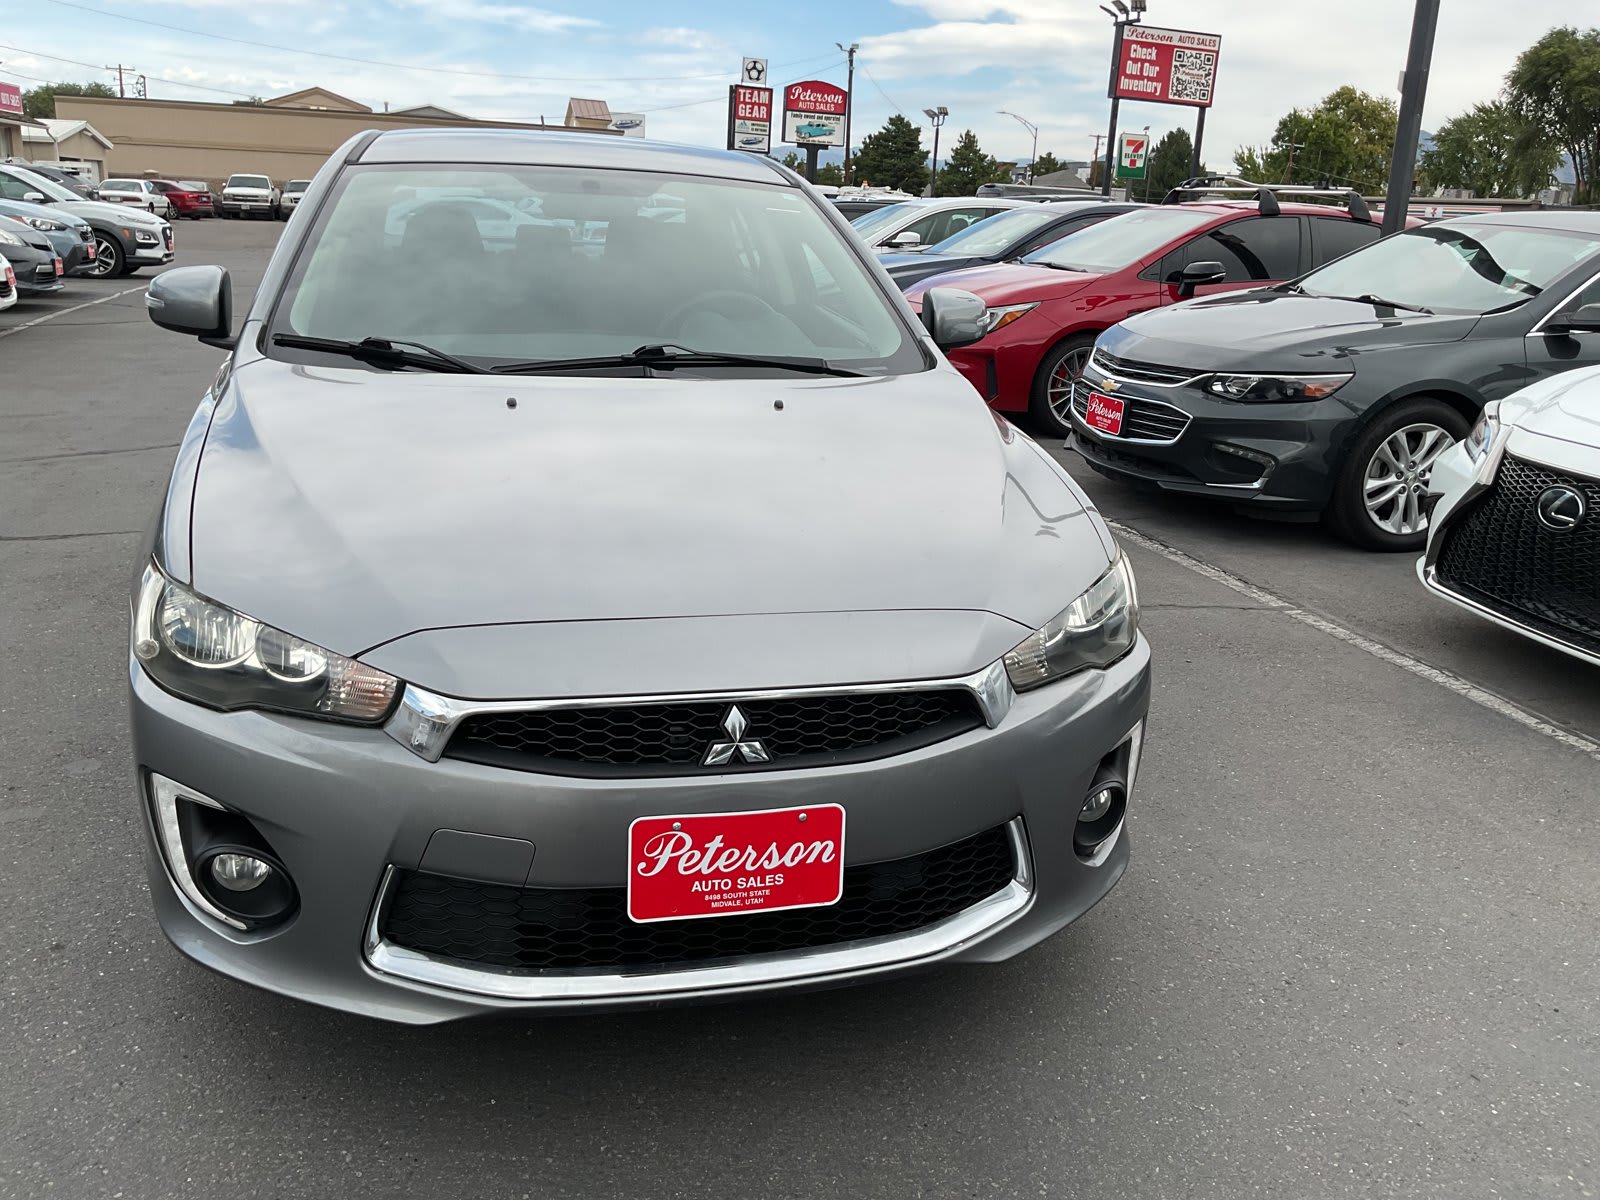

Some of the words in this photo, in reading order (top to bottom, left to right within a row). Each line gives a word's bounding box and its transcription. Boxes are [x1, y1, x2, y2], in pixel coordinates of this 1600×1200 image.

[1127, 27, 1173, 43] Peterson
[1178, 35, 1195, 45] AUTO
[1196, 37, 1217, 48] SALES
[1130, 44, 1157, 60] Check
[1126, 60, 1141, 75] Out
[1143, 63, 1160, 77] Our
[1120, 76, 1162, 96] Inventory
[738, 89, 769, 104] TEAM
[790, 86, 843, 104] Peterson
[738, 104, 767, 119] GEAR
[798, 101, 816, 110] AUTO
[816, 103, 835, 112] SALES
[1089, 398, 1121, 420] Peterson
[637, 831, 836, 877] Peterson
[691, 879, 732, 892] AUTO
[737, 874, 784, 889] SALES
[723, 892, 747, 900] SOUTH
[749, 889, 771, 897] STATE
[745, 897, 764, 905] UTAH
